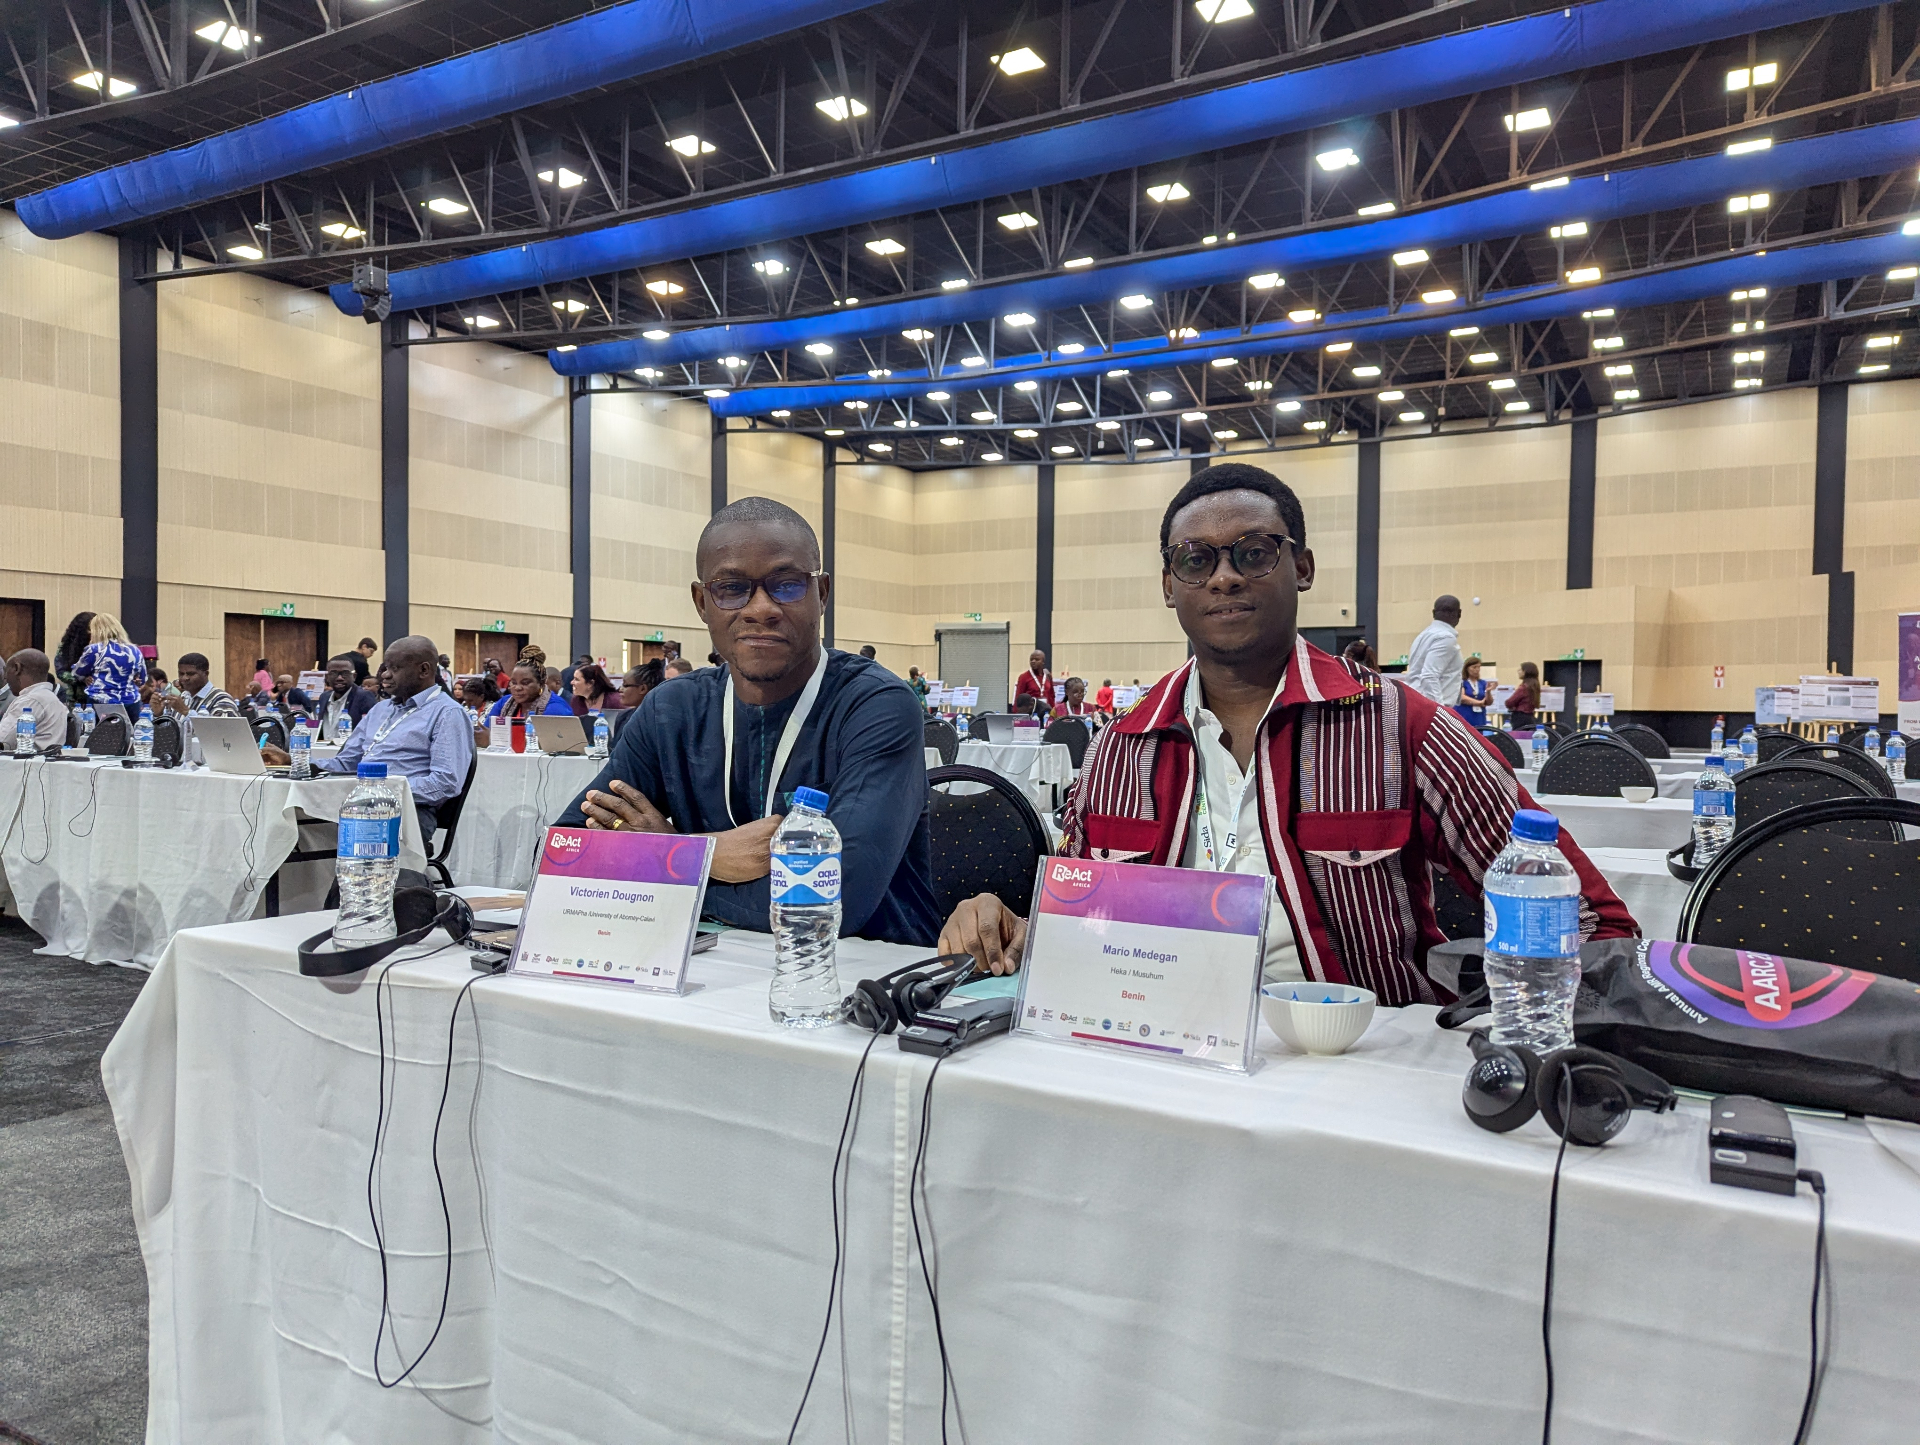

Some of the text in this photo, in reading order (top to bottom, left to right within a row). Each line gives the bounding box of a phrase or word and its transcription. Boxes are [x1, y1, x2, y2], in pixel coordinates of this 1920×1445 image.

[551, 833, 581, 849] ReAct
[1200, 825, 1212, 848] Sida
[1052, 864, 1092, 882] ReAct
[570, 886, 655, 904] Victorien Dougnon
[1102, 944, 1178, 964] Mario Medegan
[1498, 941, 1509, 951] 500
[1110, 966, 1128, 976] Heka
[1132, 969, 1165, 981] Musuhum
[1636, 951, 1654, 980] Regional
[1748, 960, 1782, 1011] AARC
[1121, 990, 1146, 1001] Benin
[1664, 992, 1709, 1024] Annual
